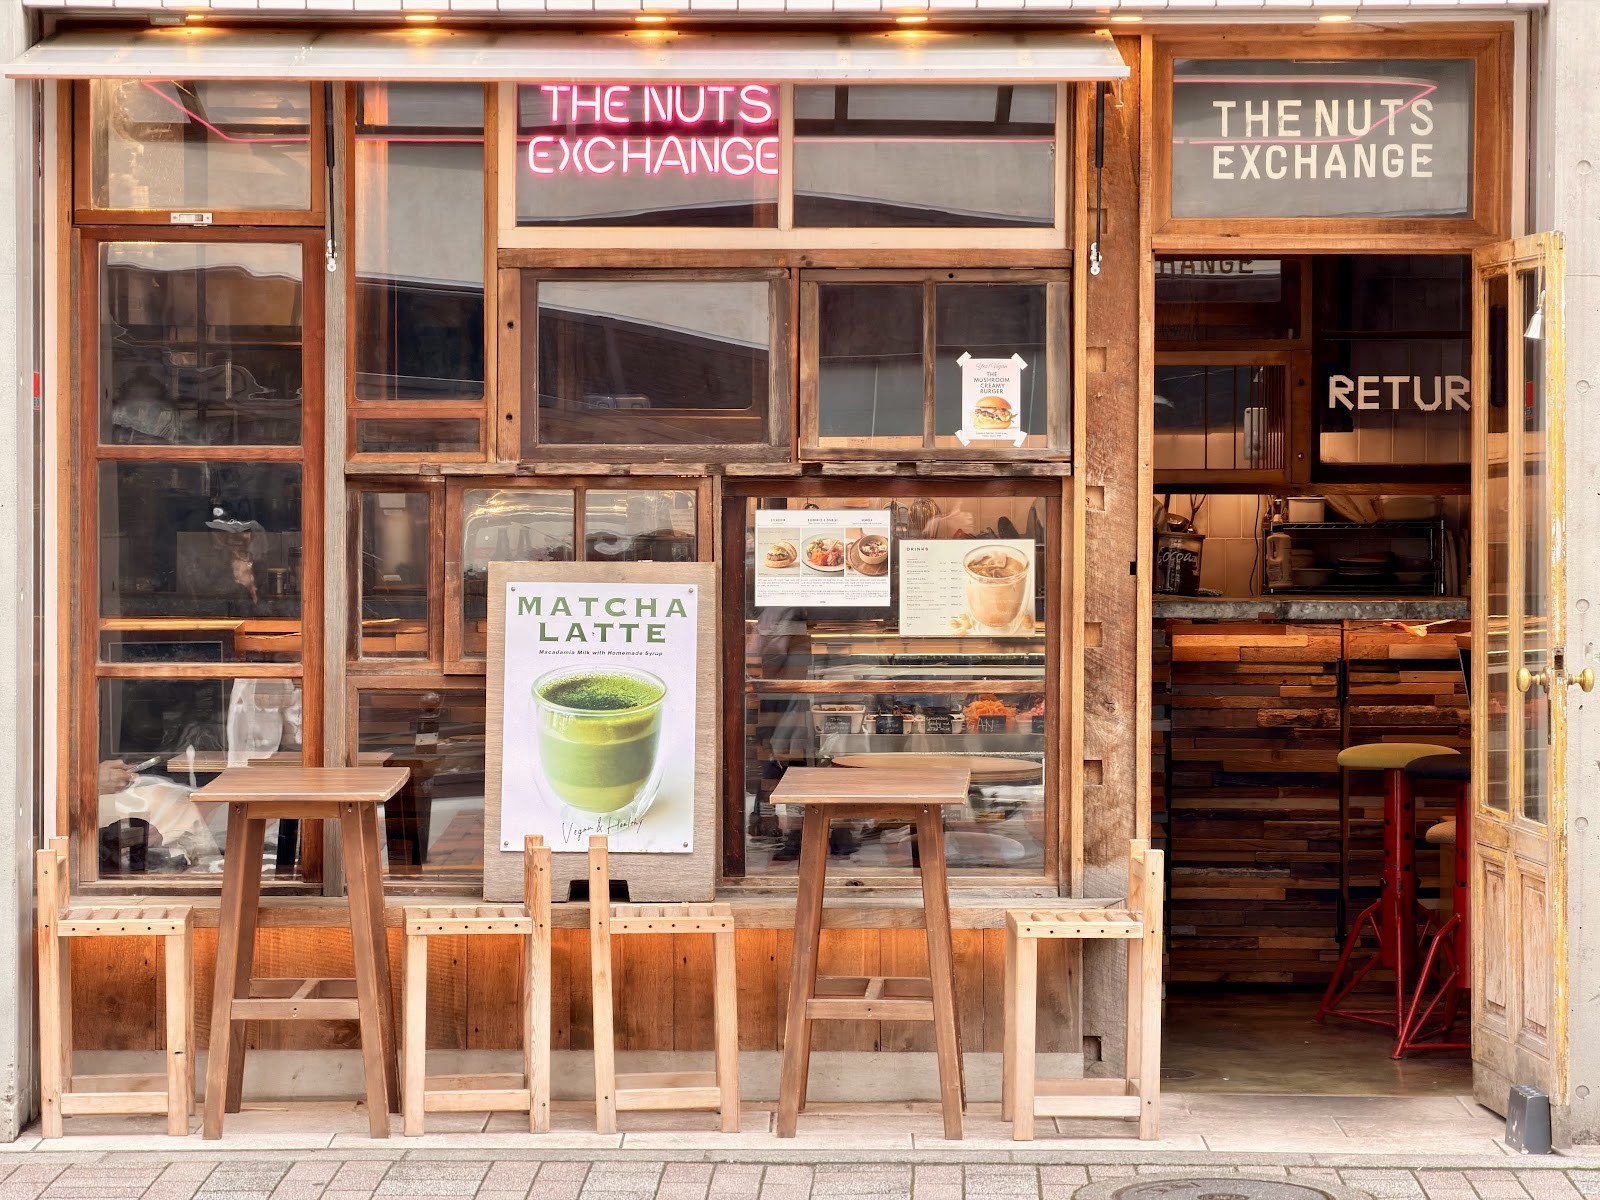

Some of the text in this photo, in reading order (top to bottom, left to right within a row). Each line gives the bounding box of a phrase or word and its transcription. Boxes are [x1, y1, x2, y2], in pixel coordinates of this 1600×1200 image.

[541, 84, 773, 123] THE NUTS
[1212, 98, 1434, 138] THE NUTS
[527, 136, 779, 176] EXCHANGE
[1212, 143, 1433, 180] EXCHANGE
[1328, 374, 1472, 411] RETUR
[517, 596, 688, 618] MATCHA
[539, 622, 666, 644] LATTE
[562, 821, 593, 844] Vegan
[596, 816, 603, 833] &
